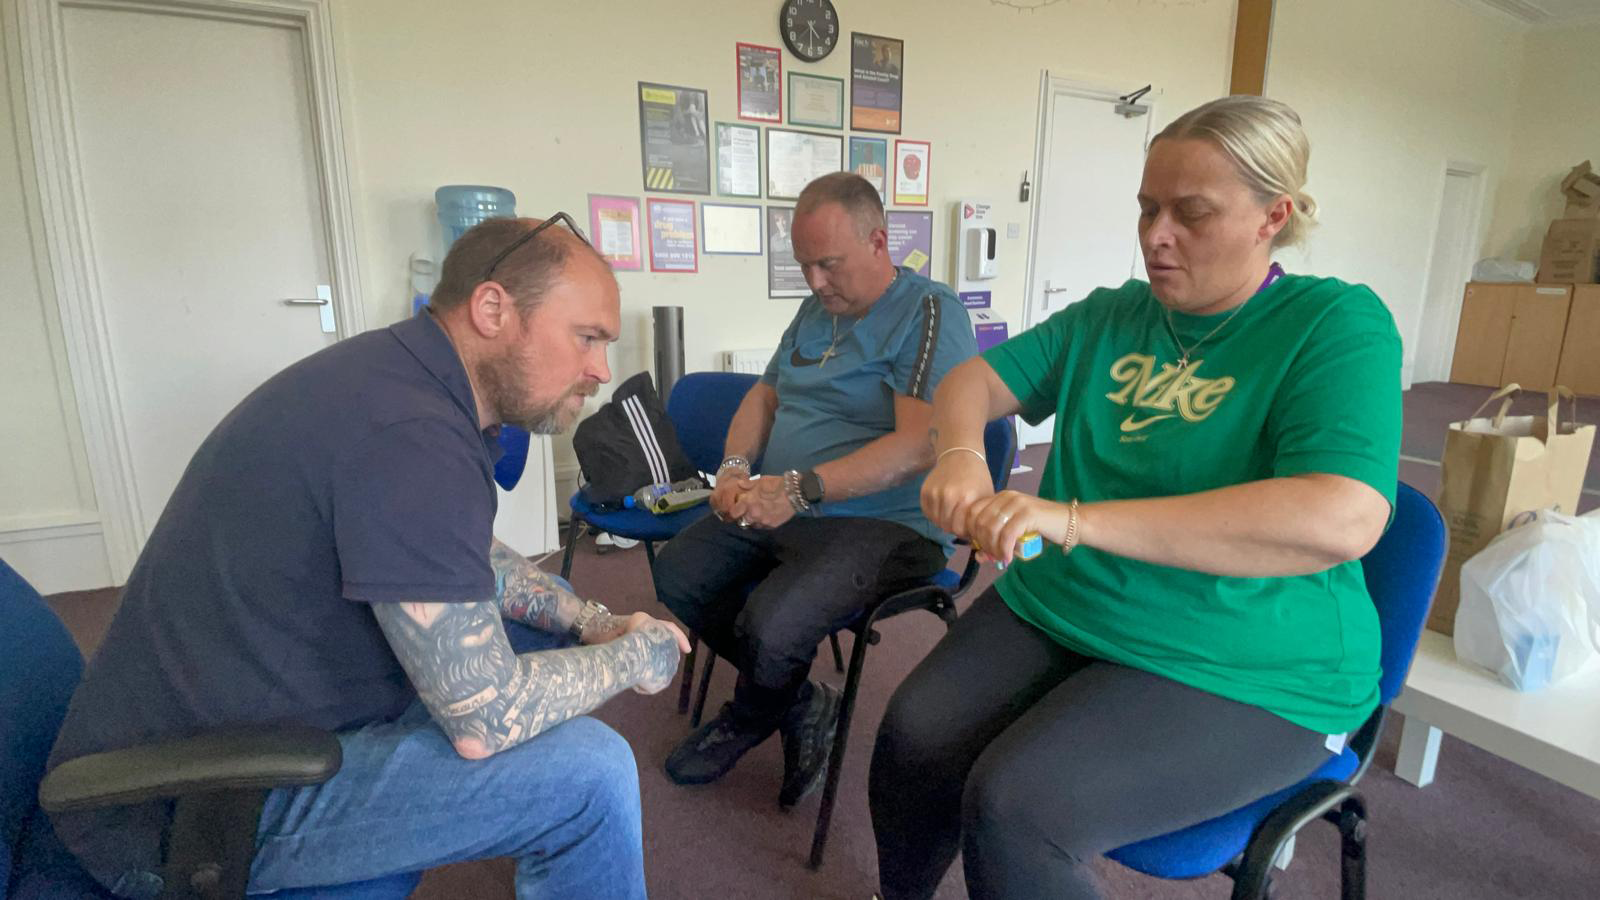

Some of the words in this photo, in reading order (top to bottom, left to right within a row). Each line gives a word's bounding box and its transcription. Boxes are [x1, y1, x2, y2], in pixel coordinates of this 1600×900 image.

[789, 6, 797, 15] 10
[825, 10, 831, 19] 2
[787, 18, 793, 27] 9
[828, 24, 834, 34] 3
[790, 31, 796, 41] 8
[825, 37, 831, 45] 4
[797, 42, 803, 51] 7
[817, 46, 823, 55] 5
[808, 47, 813, 56] 6
[655, 219, 673, 231] drug
[661, 230, 694, 240] problem
[1105, 352, 1236, 422] Nike
